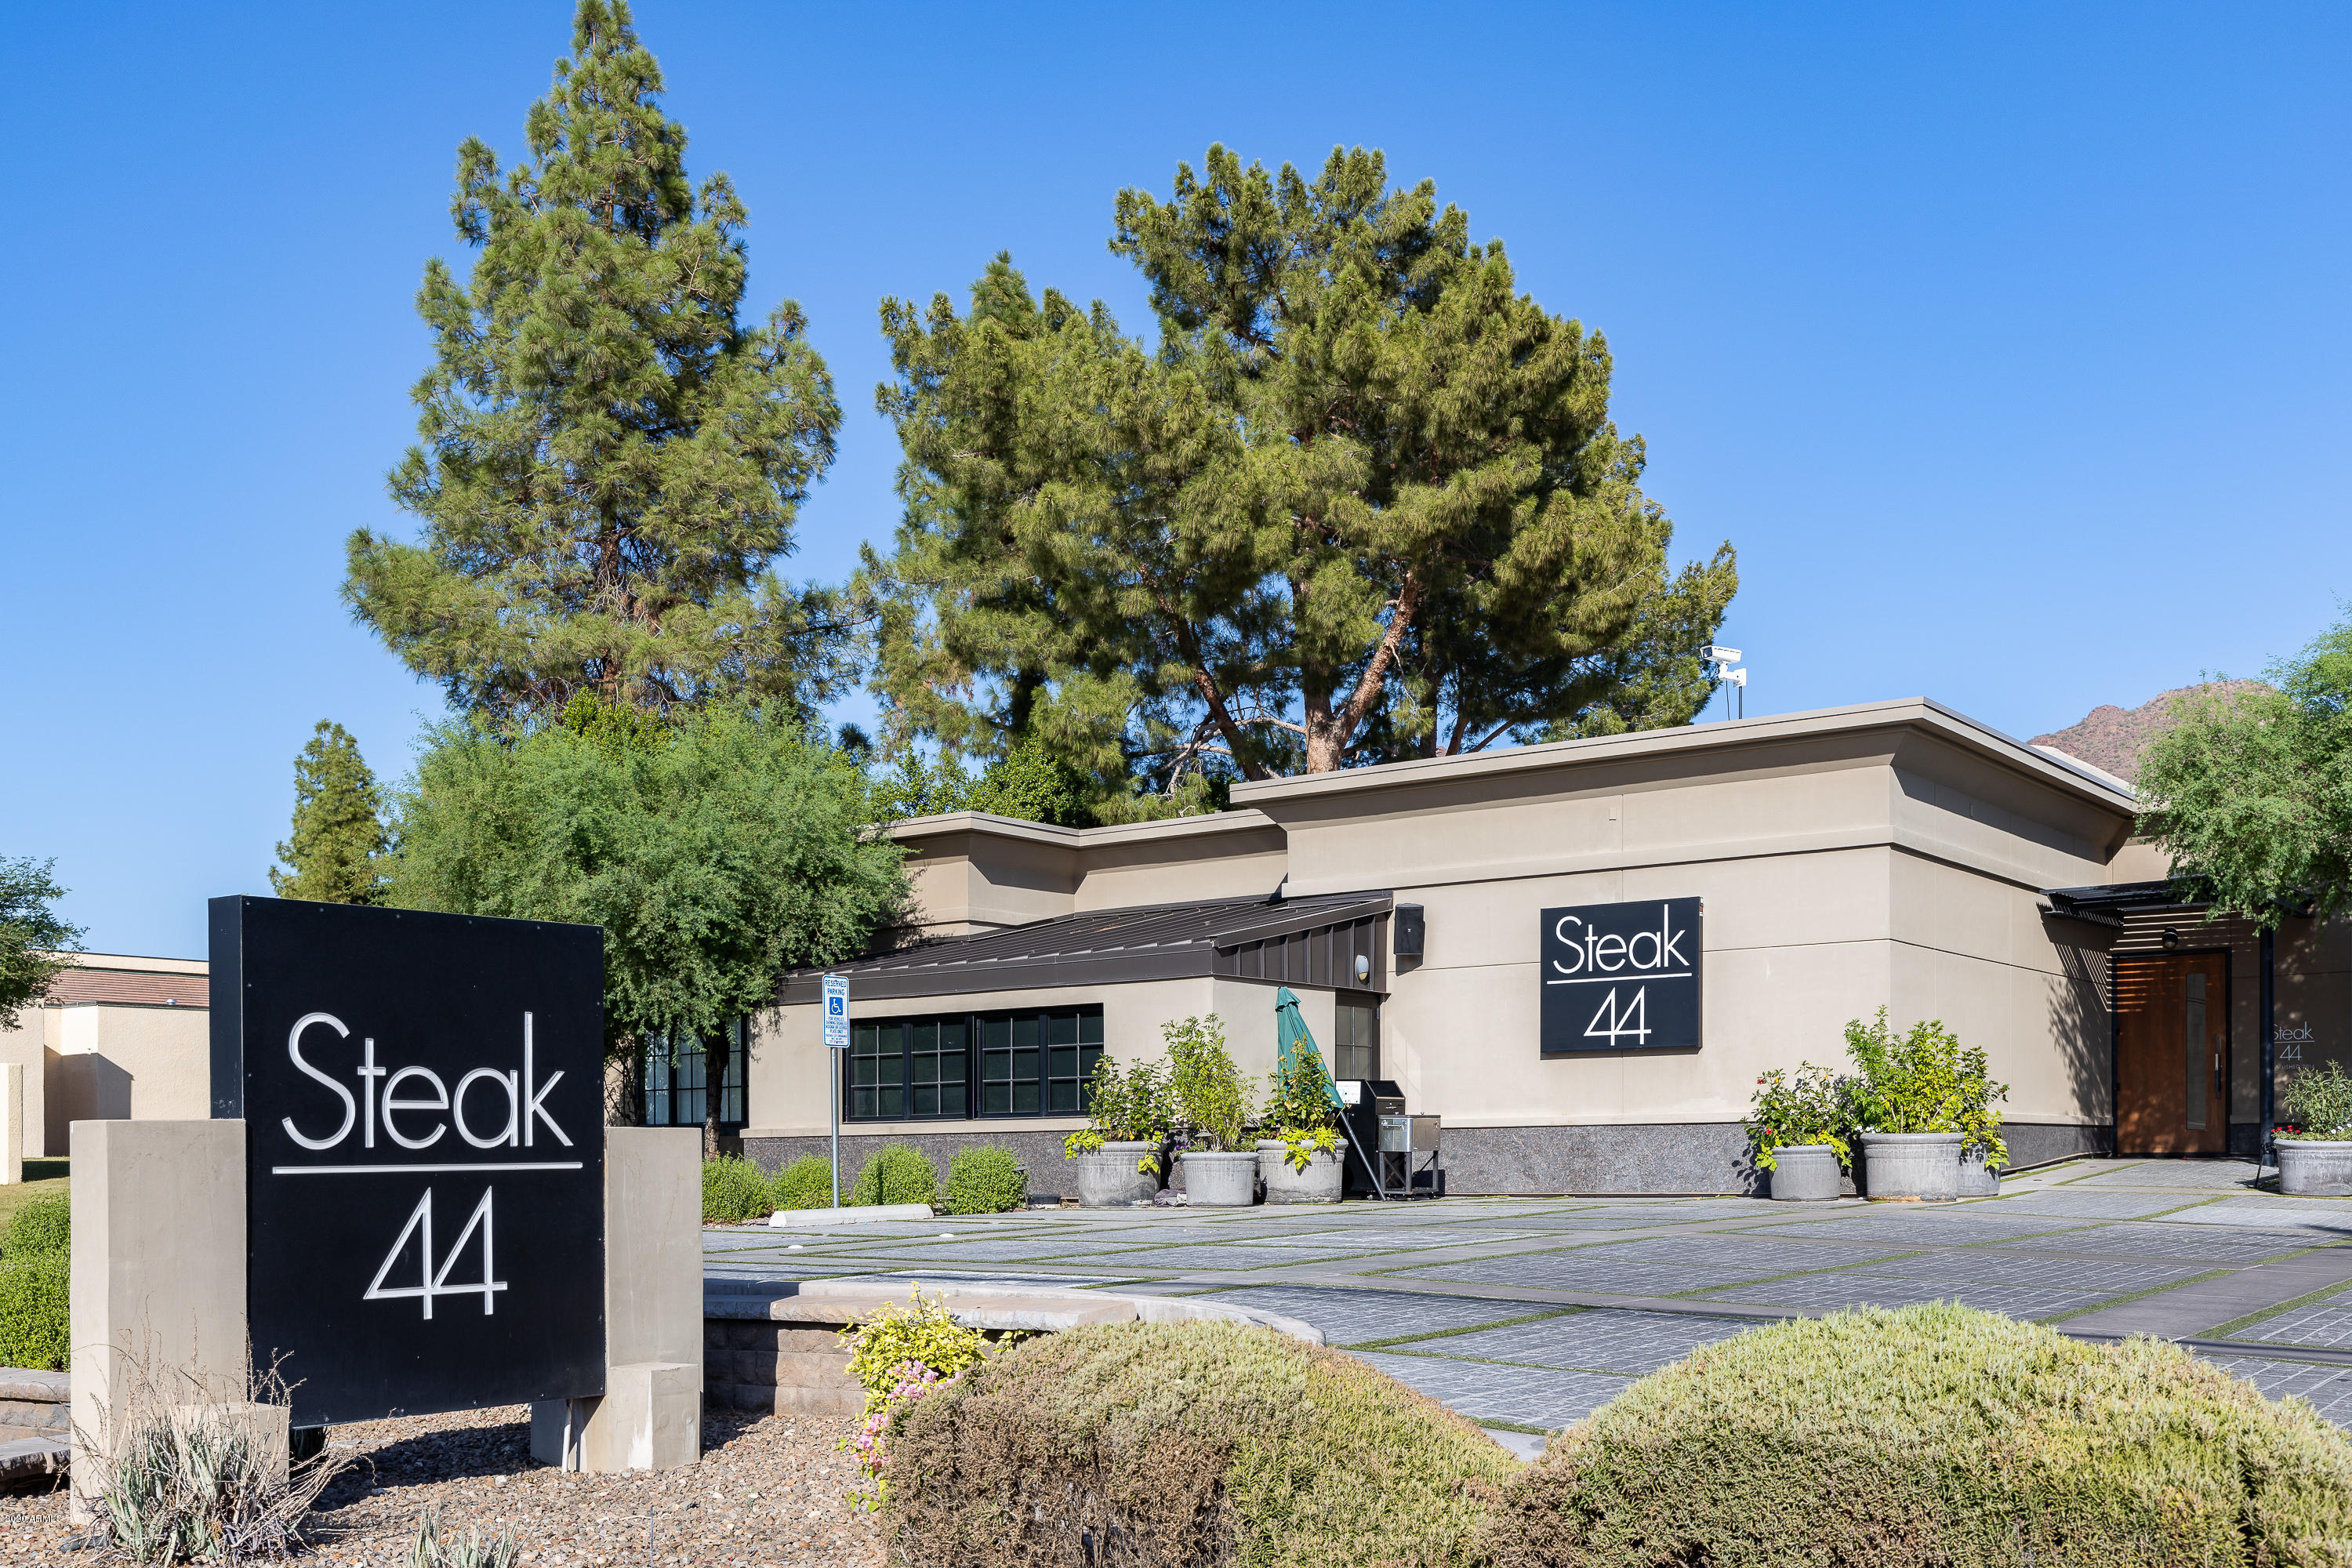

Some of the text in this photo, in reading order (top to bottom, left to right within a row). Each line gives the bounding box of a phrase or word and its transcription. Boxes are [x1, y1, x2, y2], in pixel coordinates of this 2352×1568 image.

[1553, 904, 1690, 974] Steak
[825, 979, 847, 988] RESERVED
[1584, 985, 1652, 1047] 44
[281, 1011, 574, 1150] Steak
[2279, 1044, 2303, 1062] 44
[362, 1185, 508, 1320] 44
